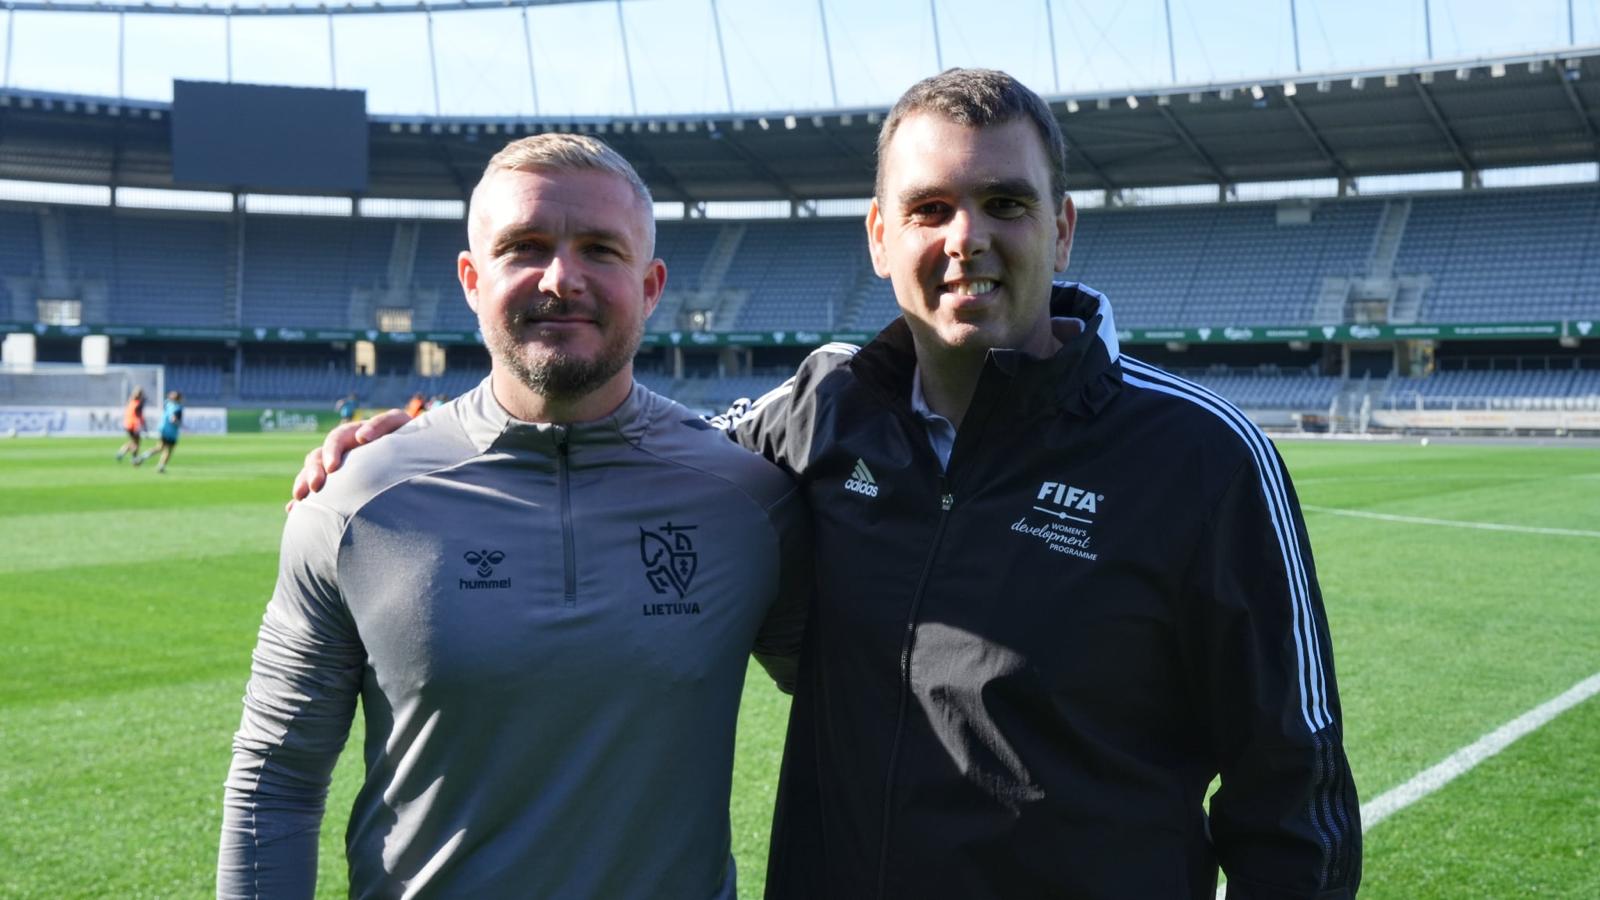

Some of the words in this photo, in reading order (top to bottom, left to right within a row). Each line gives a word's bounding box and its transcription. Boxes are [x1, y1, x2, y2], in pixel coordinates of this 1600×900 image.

[845, 479, 878, 497] adidas
[1037, 481, 1097, 513] FIFA
[1011, 517, 1091, 549] development
[1051, 522, 1087, 537] WOMEN'S
[1049, 543, 1098, 561] PROGRAMME
[459, 577, 511, 590] hummel
[643, 603, 700, 616] LIETUVA
